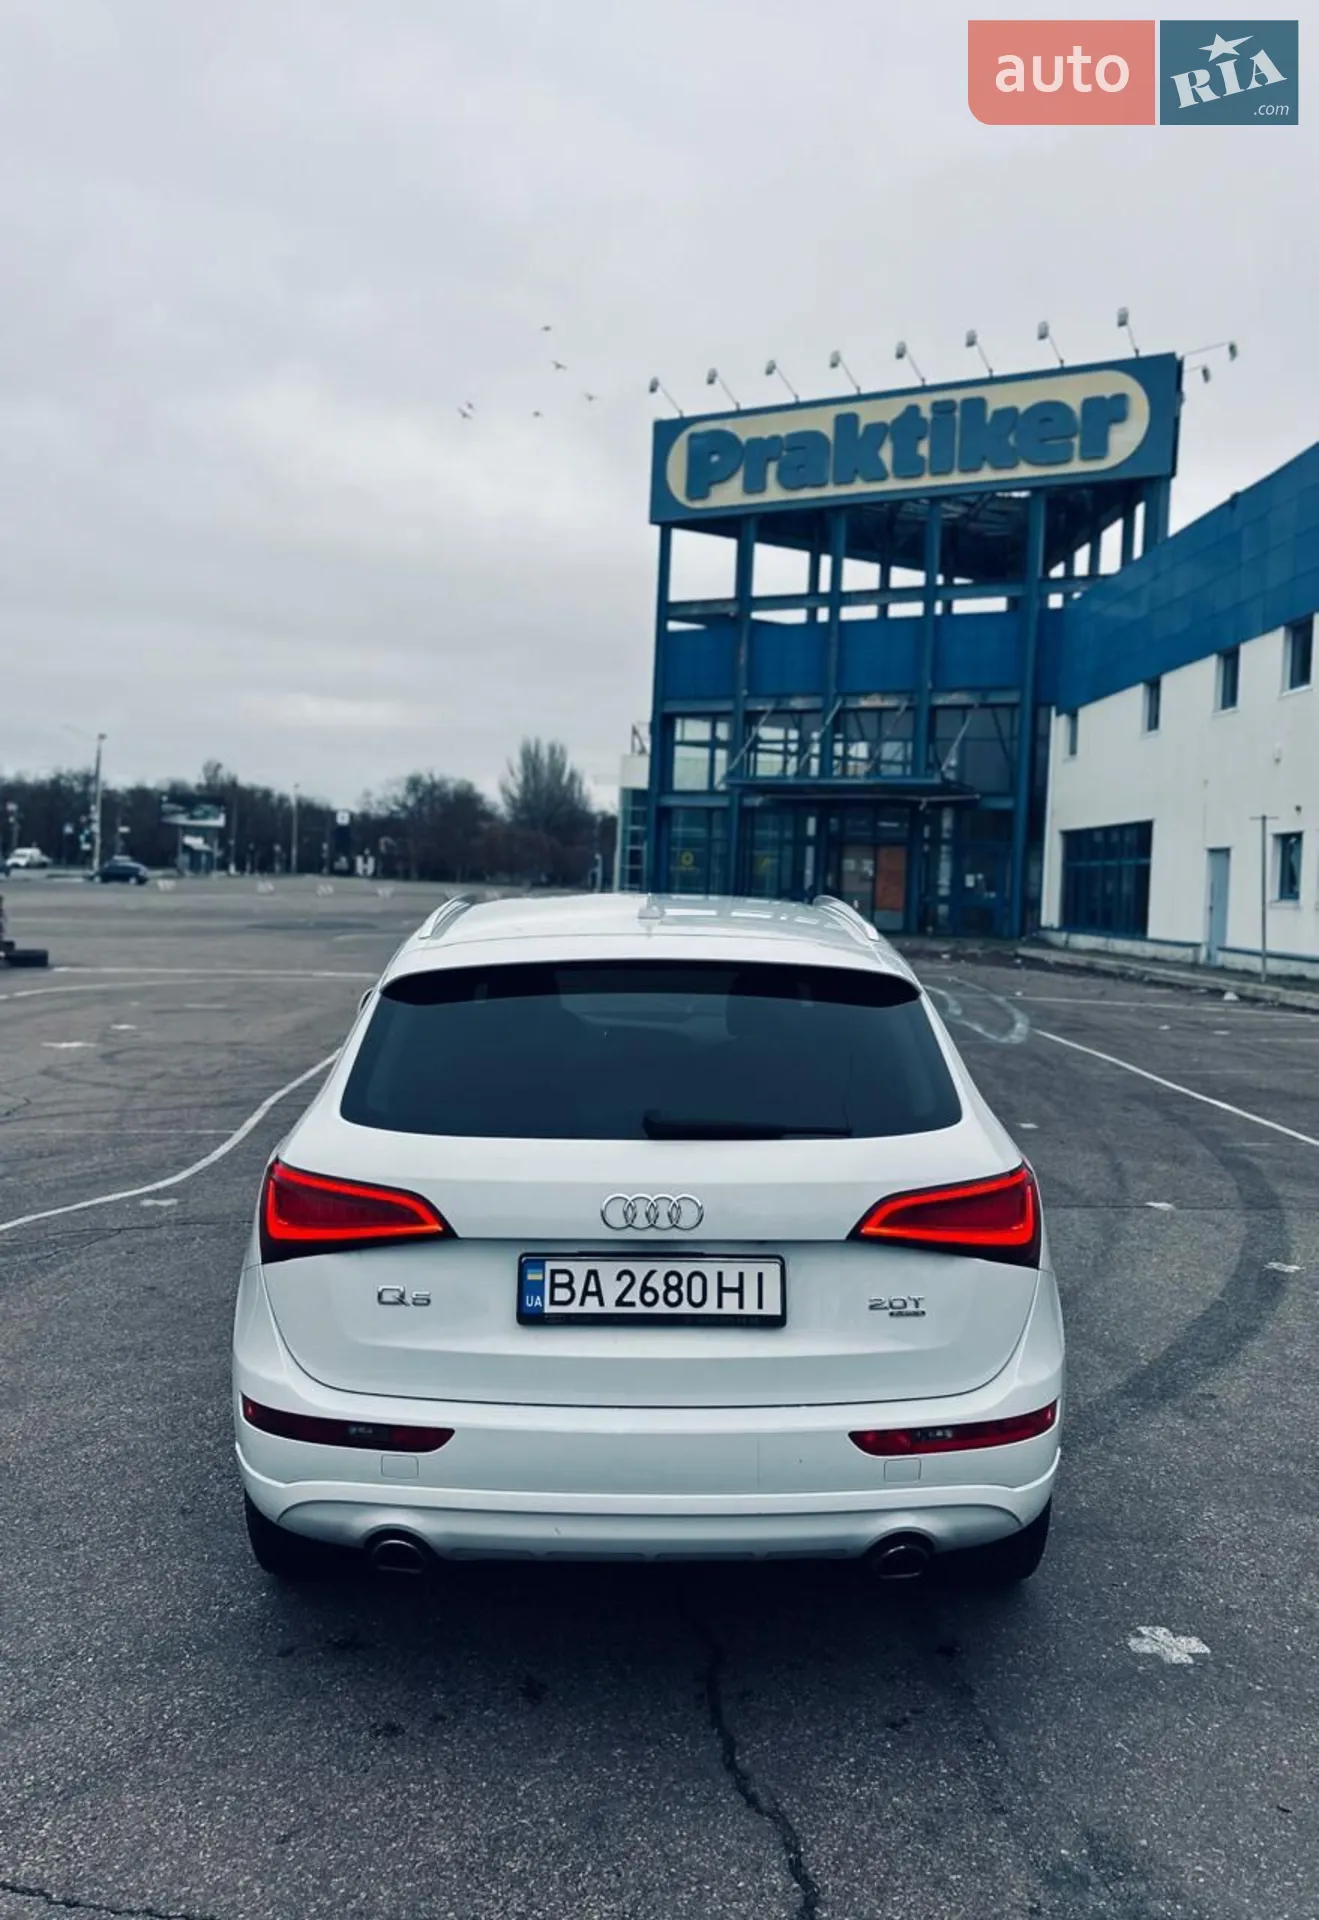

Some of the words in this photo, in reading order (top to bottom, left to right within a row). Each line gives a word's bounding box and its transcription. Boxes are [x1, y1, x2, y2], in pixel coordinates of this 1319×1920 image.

[685, 393, 1130, 501] Praktiker
[377, 1285, 432, 1307] Q5
[525, 1296, 543, 1308] UA
